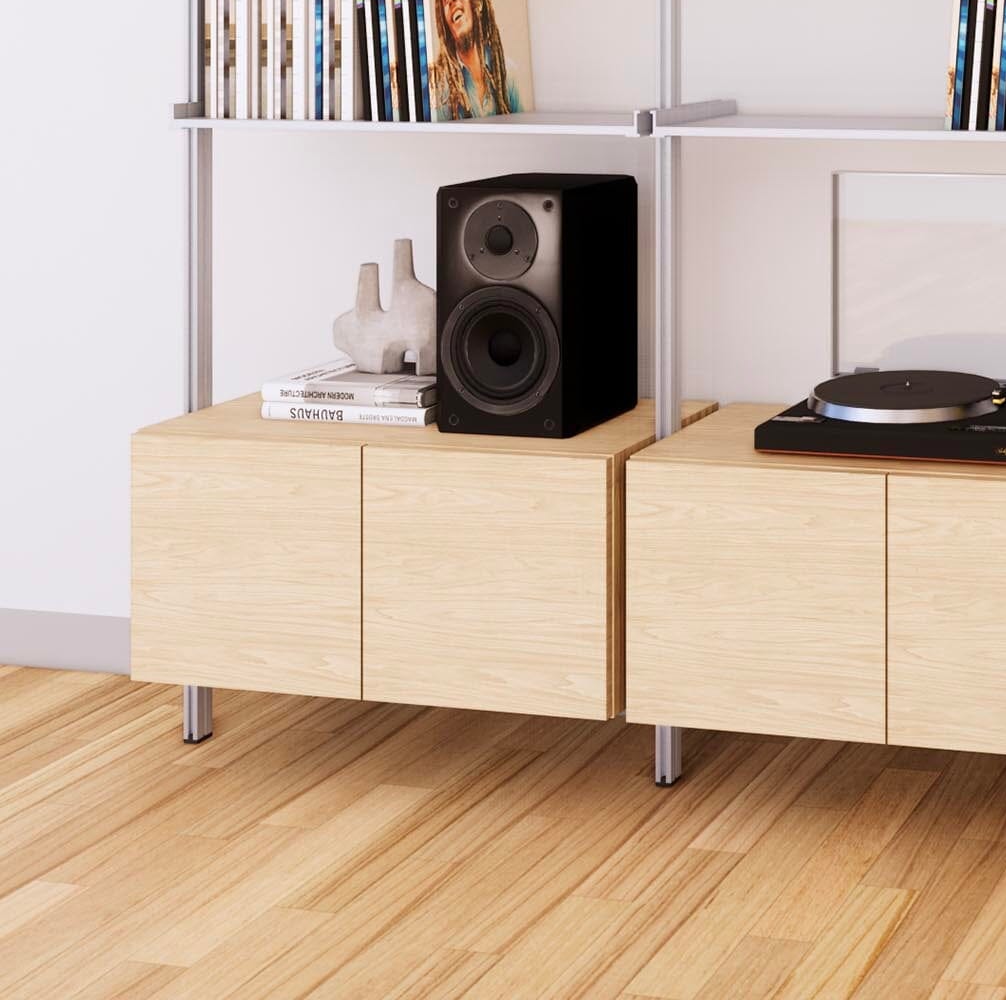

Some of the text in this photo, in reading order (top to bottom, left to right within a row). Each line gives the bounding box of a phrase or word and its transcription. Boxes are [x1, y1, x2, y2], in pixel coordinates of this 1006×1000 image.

[280, 389, 354, 400] MODERN ARCHITECTURE
[290, 408, 344, 421] BAUHAUS
